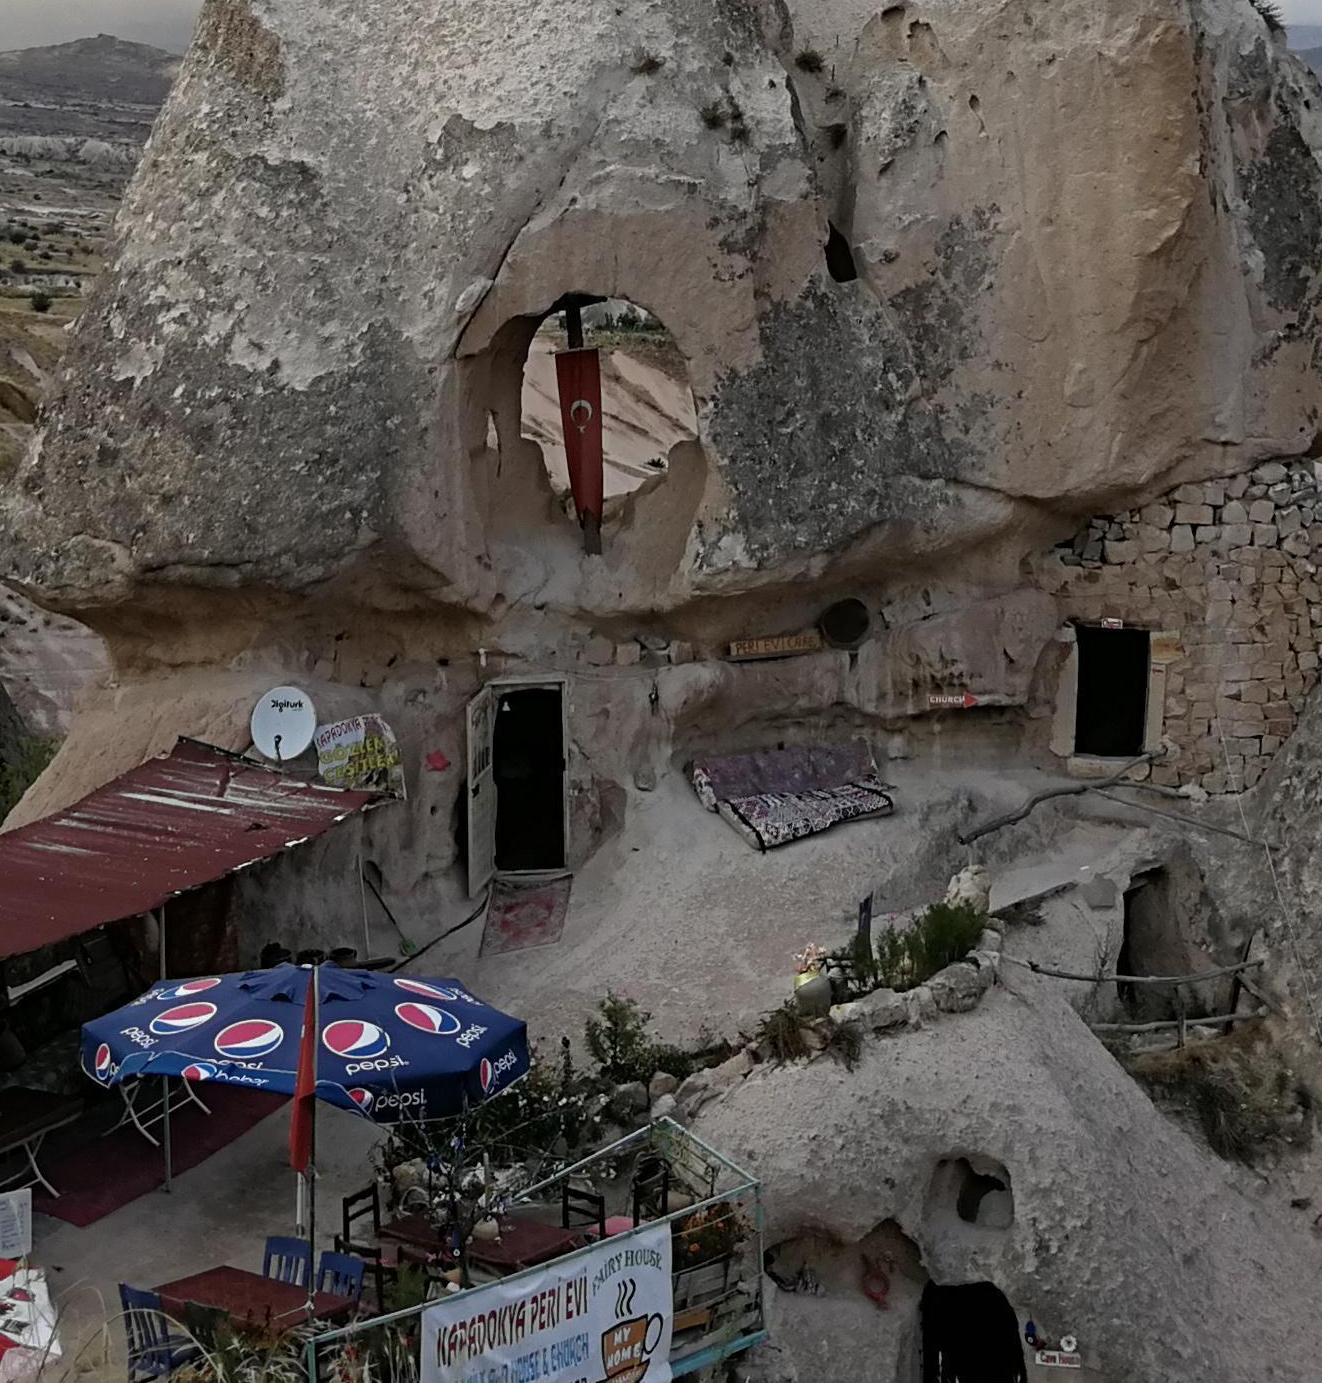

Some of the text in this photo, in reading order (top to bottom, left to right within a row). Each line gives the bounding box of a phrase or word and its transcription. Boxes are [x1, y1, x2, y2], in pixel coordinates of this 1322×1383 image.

[929, 695, 966, 704] CHURCH
[345, 1055, 405, 1076] pepsi
[375, 1088, 425, 1112] pepsi
[624, 1248, 662, 1271] HOUSE
[437, 1300, 526, 1368] KAPADOKYA
[613, 1327, 631, 1346] MY
[606, 1342, 642, 1370] HOME
